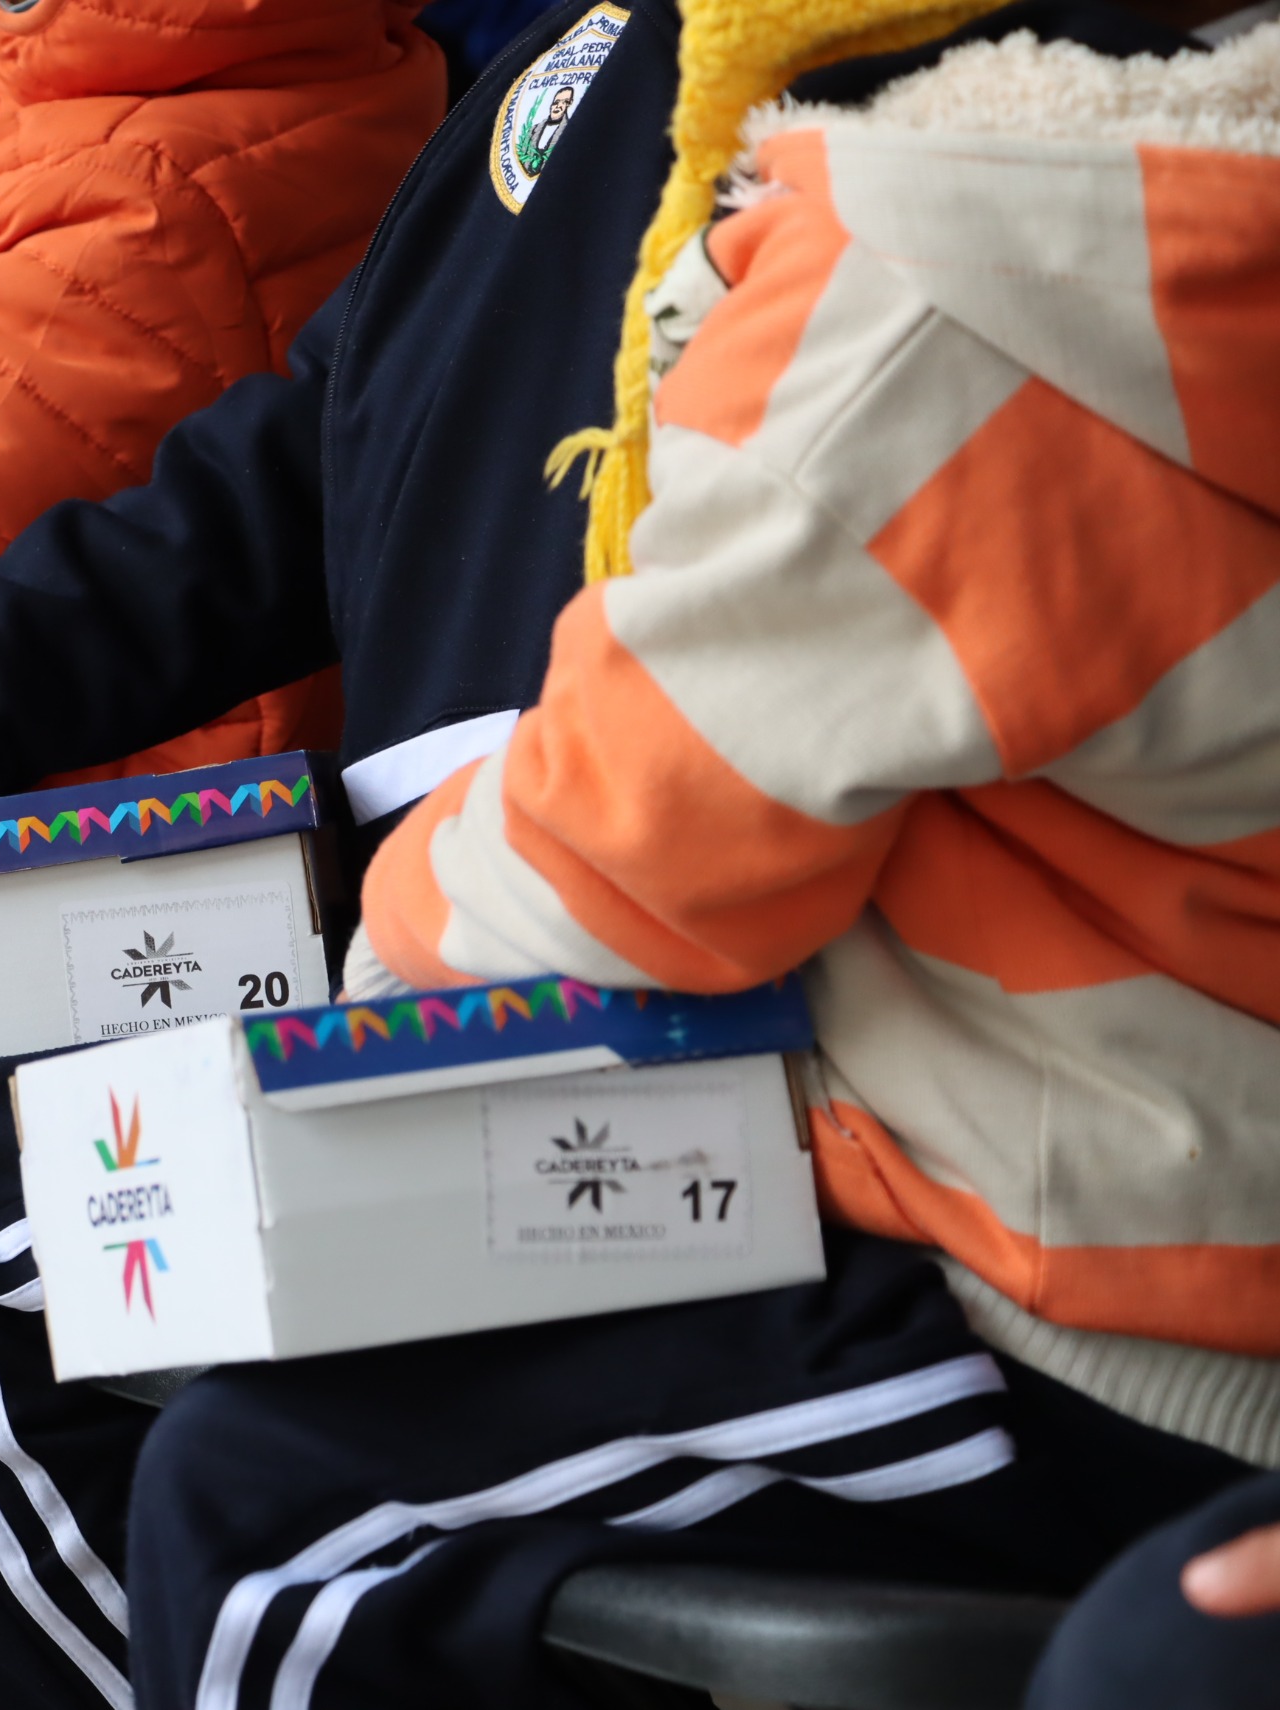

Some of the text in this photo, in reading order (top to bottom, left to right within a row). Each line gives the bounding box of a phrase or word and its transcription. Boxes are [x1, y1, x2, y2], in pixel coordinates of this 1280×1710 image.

[110, 960, 202, 980] CADEREYTA
[238, 971, 290, 1010] 20
[100, 1020, 149, 1036] HECHO
[153, 1018, 170, 1030] EN
[535, 1157, 641, 1175] CADEREYTA
[87, 1184, 174, 1228] CADEREYTA
[681, 1179, 738, 1222] 17
[604, 1223, 667, 1240] MEXICO
